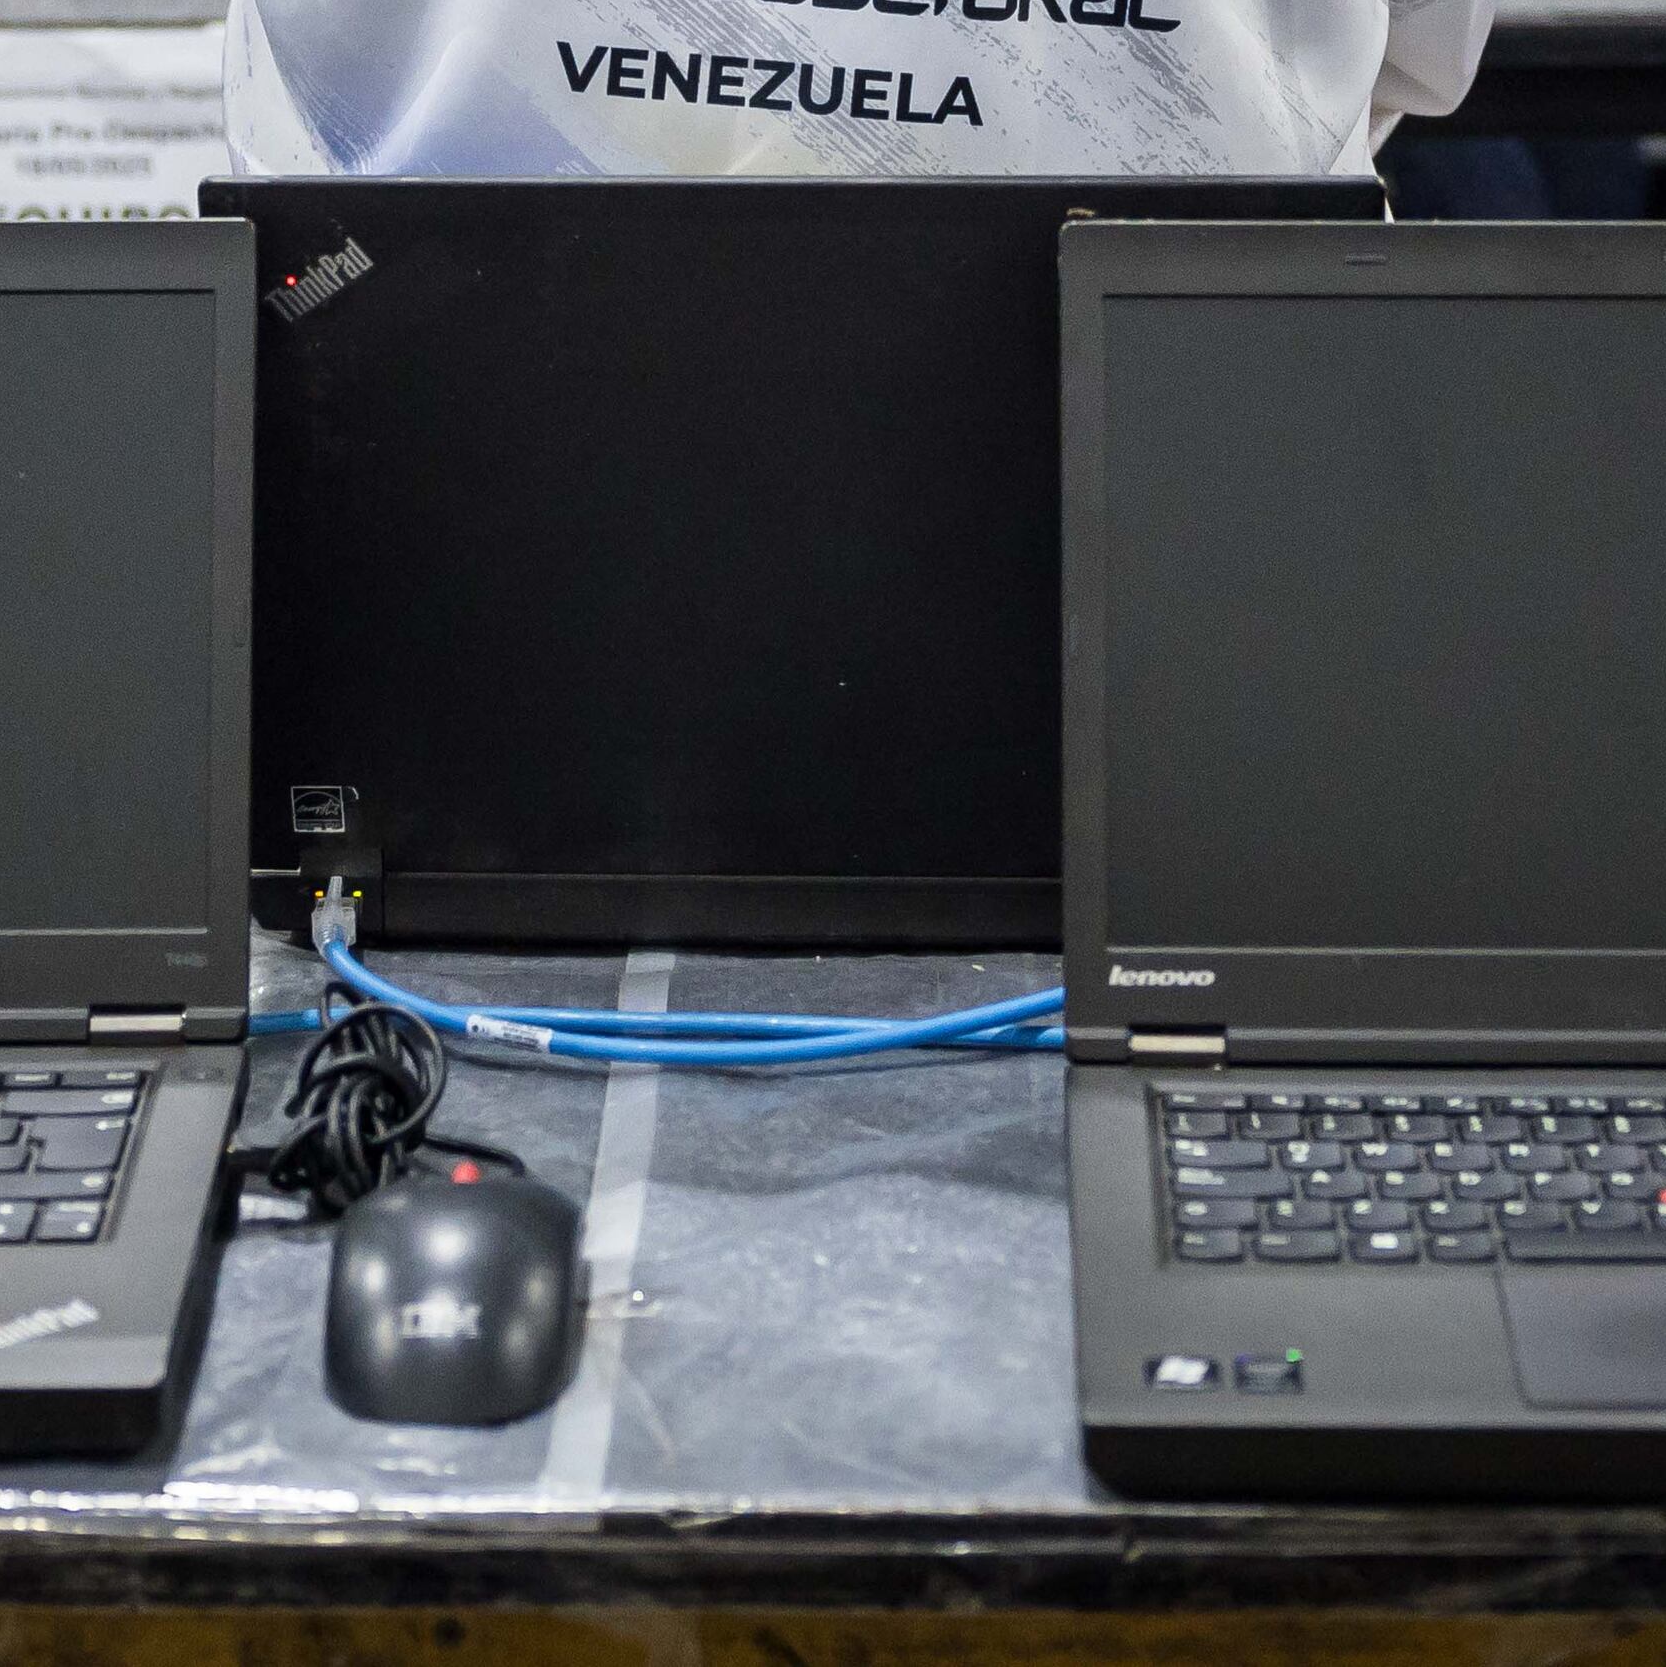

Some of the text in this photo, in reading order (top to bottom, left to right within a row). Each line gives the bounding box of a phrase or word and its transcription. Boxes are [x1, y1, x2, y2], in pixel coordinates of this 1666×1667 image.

[556, 40, 984, 127] VENEZUELA
[264, 237, 374, 323] ThinkPad
[1108, 964, 1216, 987] lenovo
